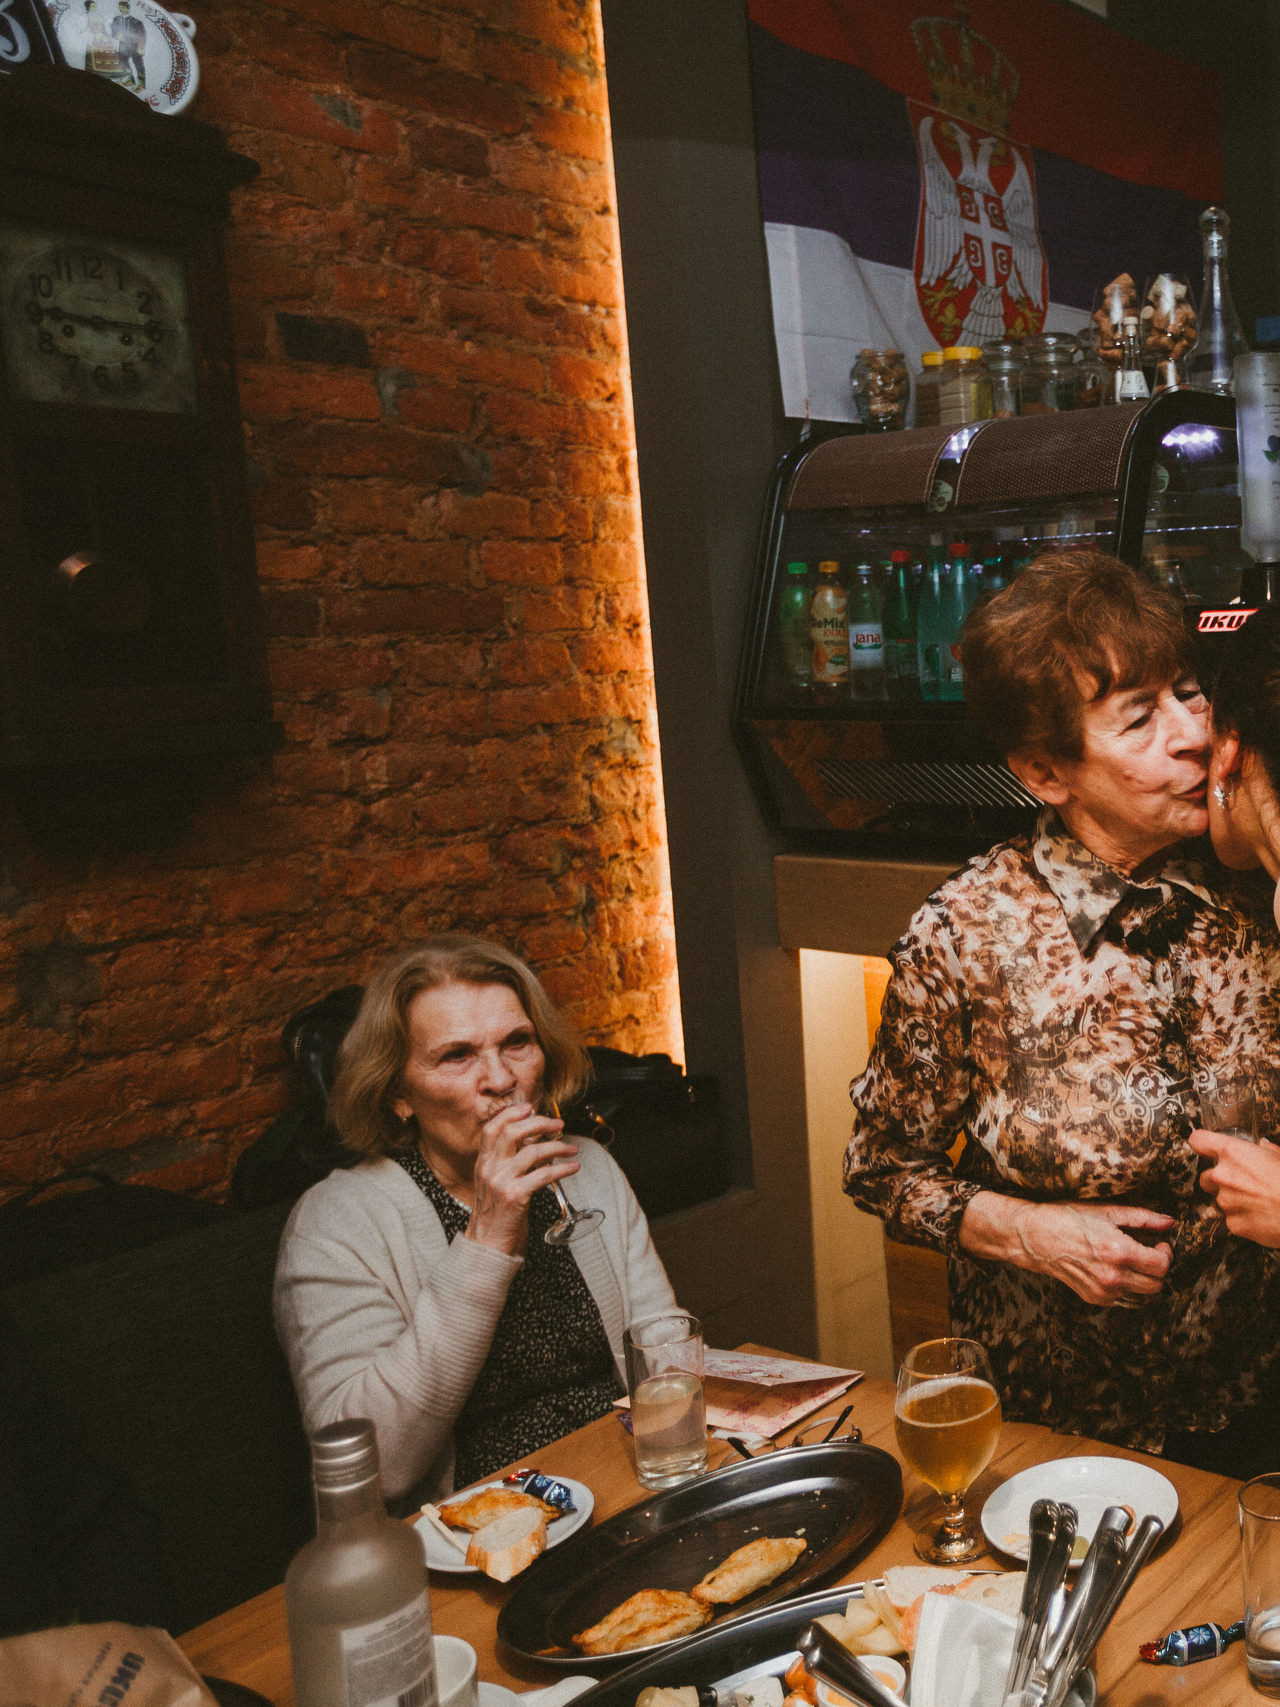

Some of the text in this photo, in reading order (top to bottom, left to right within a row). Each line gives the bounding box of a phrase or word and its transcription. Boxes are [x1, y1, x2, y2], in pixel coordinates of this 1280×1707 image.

[54, 259, 72, 282] 11
[81, 256, 102, 279] 12
[29, 273, 52, 298] 10
[116, 269, 124, 291] 1
[137, 291, 153, 314] 2
[38, 331, 54, 354] 8
[93, 365, 109, 389] 6
[121, 362, 138, 387] 5
[855, 633, 880, 645] jana
